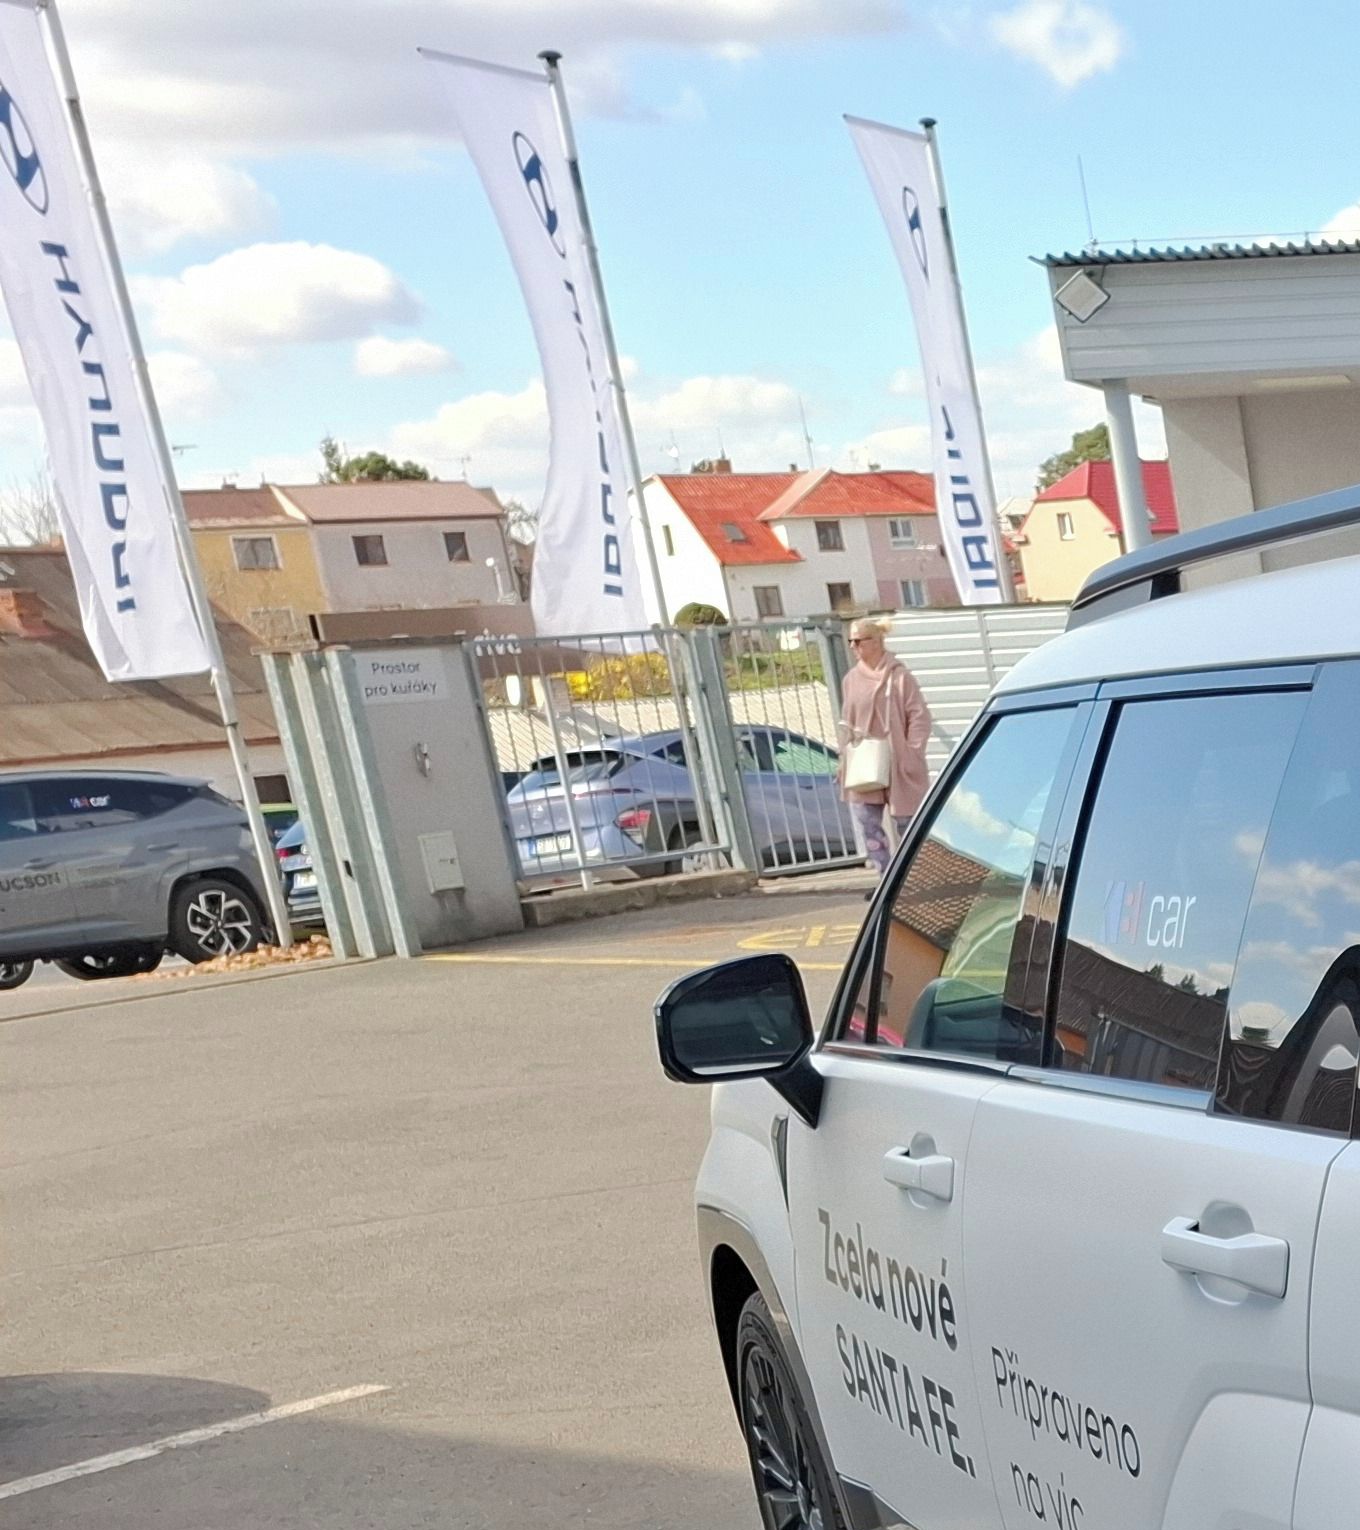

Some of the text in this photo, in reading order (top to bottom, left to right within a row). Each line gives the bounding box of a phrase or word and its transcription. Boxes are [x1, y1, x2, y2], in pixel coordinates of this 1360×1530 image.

[364, 682, 437, 699] pro kuřáky
[371, 661, 421, 675] Prostor
[1146, 895, 1197, 948] car
[818, 1207, 958, 1352] Zcela nové
[836, 1323, 977, 1480] SANTA FE.
[991, 1345, 1141, 1479] Připraveno
[1009, 1460, 1046, 1521] na
